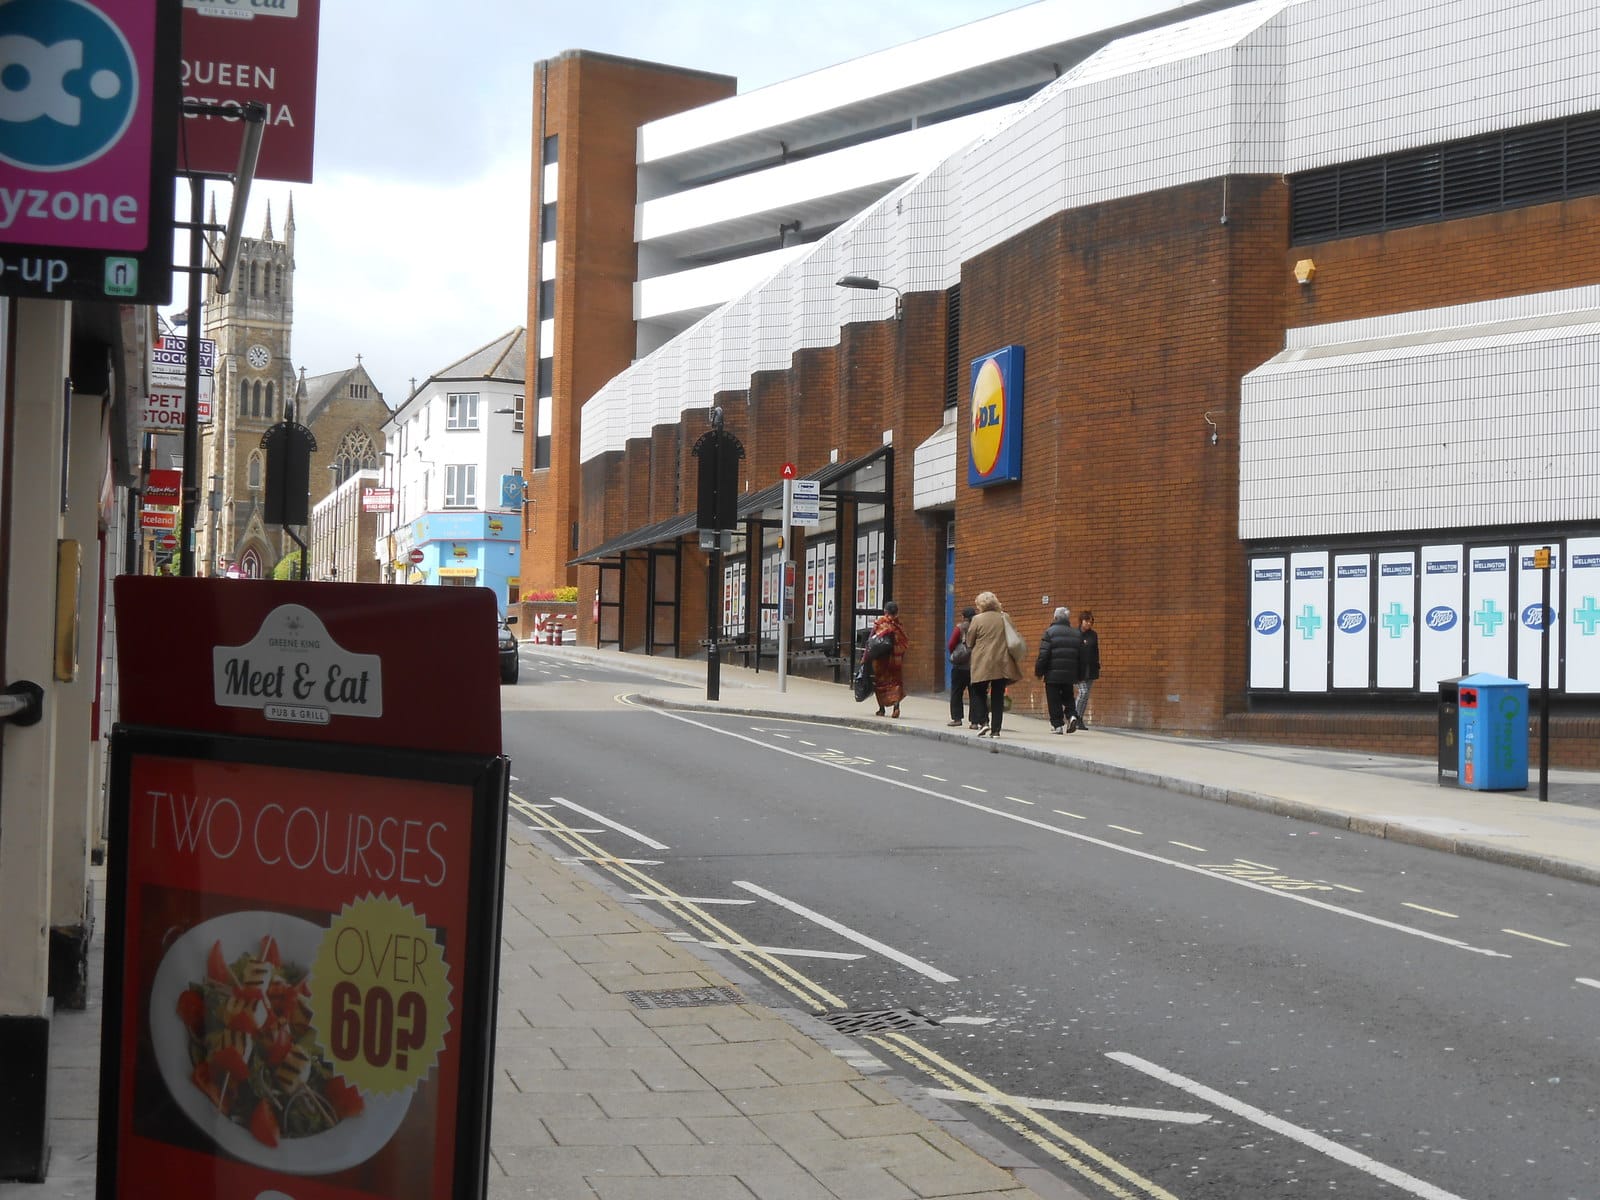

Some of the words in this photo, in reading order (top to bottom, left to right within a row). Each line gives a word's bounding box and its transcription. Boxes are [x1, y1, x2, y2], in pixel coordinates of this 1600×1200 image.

[167, 339, 210, 353] HOIS
[149, 394, 182, 408] PET
[784, 465, 792, 474] A
[144, 515, 173, 525] Iceland
[1338, 567, 1366, 575] WELLINGTON
[1382, 566, 1412, 574] WELLINGTON
[1427, 563, 1457, 571] WELLINGTON
[1474, 562, 1505, 570] WELLINGTON
[1256, 614, 1278, 631] Boots
[1339, 613, 1363, 630] Boots
[1429, 609, 1453, 627] Boots
[269, 638, 299, 648] GREENE
[300, 639, 320, 649] KING
[225, 658, 285, 698] Meet
[293, 662, 316, 700] &
[324, 664, 370, 704] Eat
[271, 707, 288, 717] PUB
[291, 709, 297, 718] &
[299, 710, 324, 720] GRILL
[147, 791, 242, 859] TWO
[255, 803, 447, 887] COURSES
[335, 926, 428, 986] OVER
[330, 980, 427, 1071] 60?
